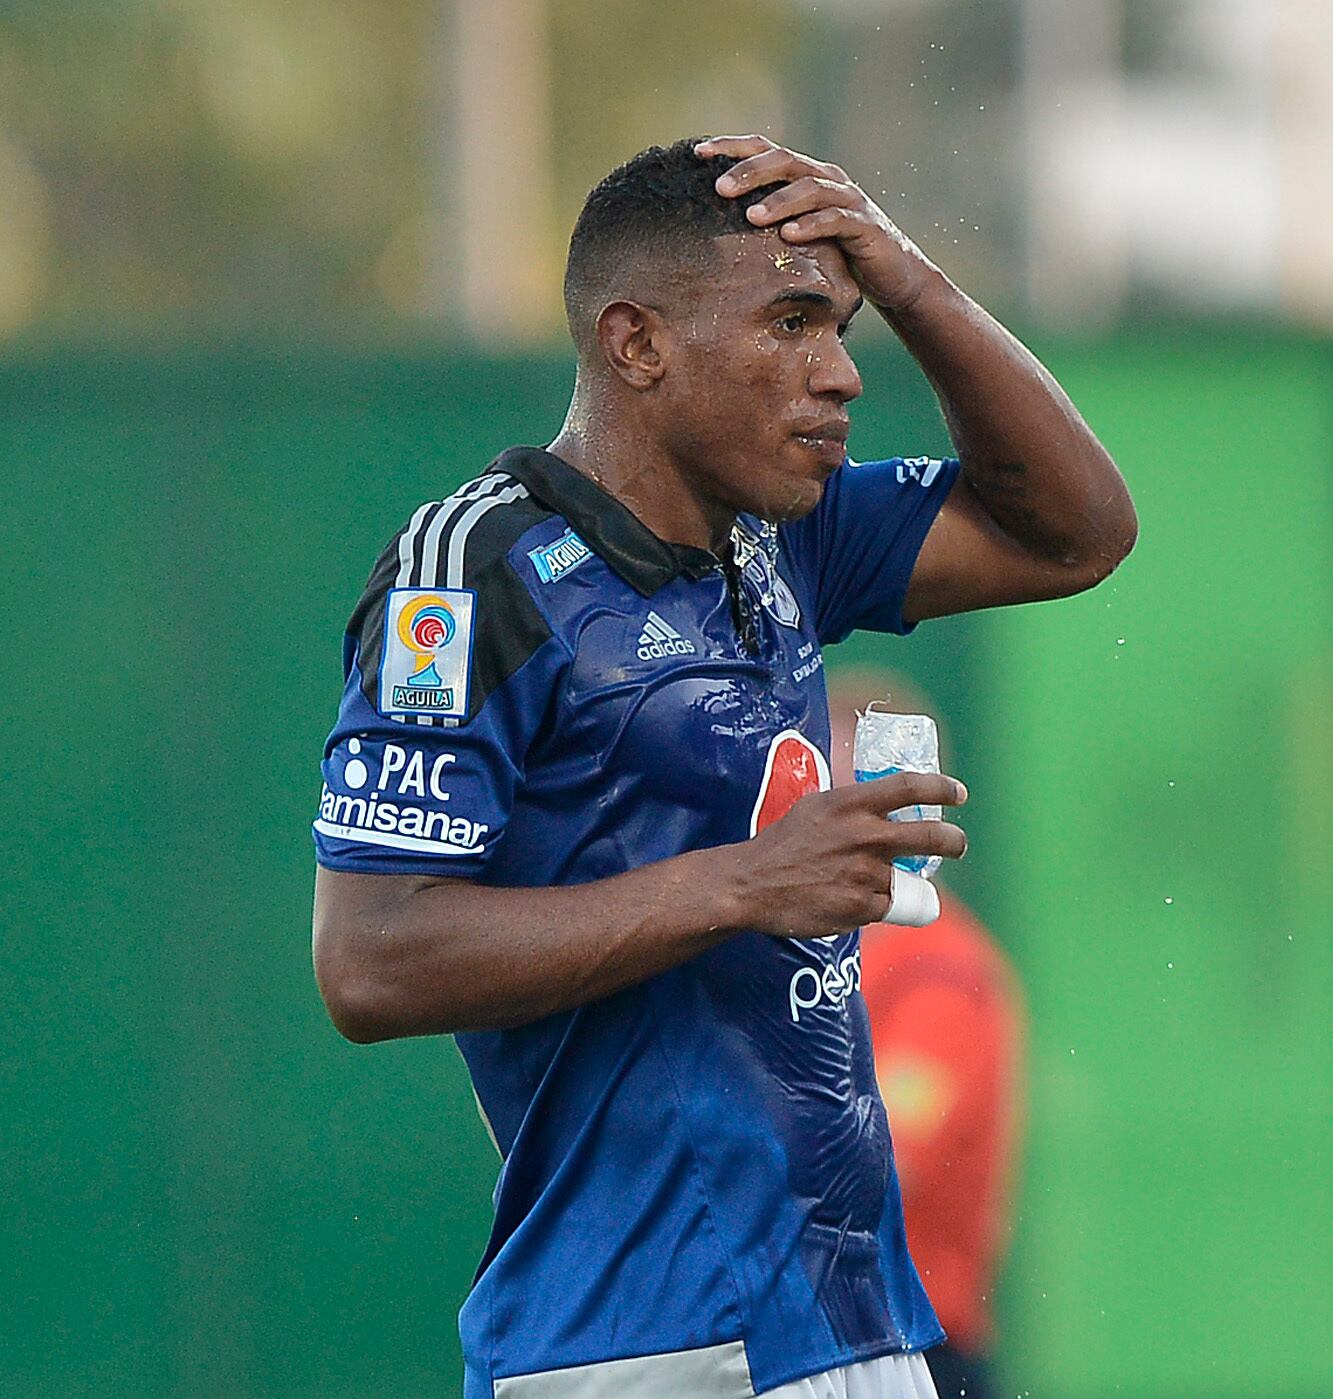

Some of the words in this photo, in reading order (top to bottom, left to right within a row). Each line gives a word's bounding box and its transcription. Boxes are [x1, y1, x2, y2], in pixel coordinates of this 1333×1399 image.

[637, 638, 696, 661] adidas
[394, 689, 451, 706] AGUILA
[377, 744, 456, 801] PAC
